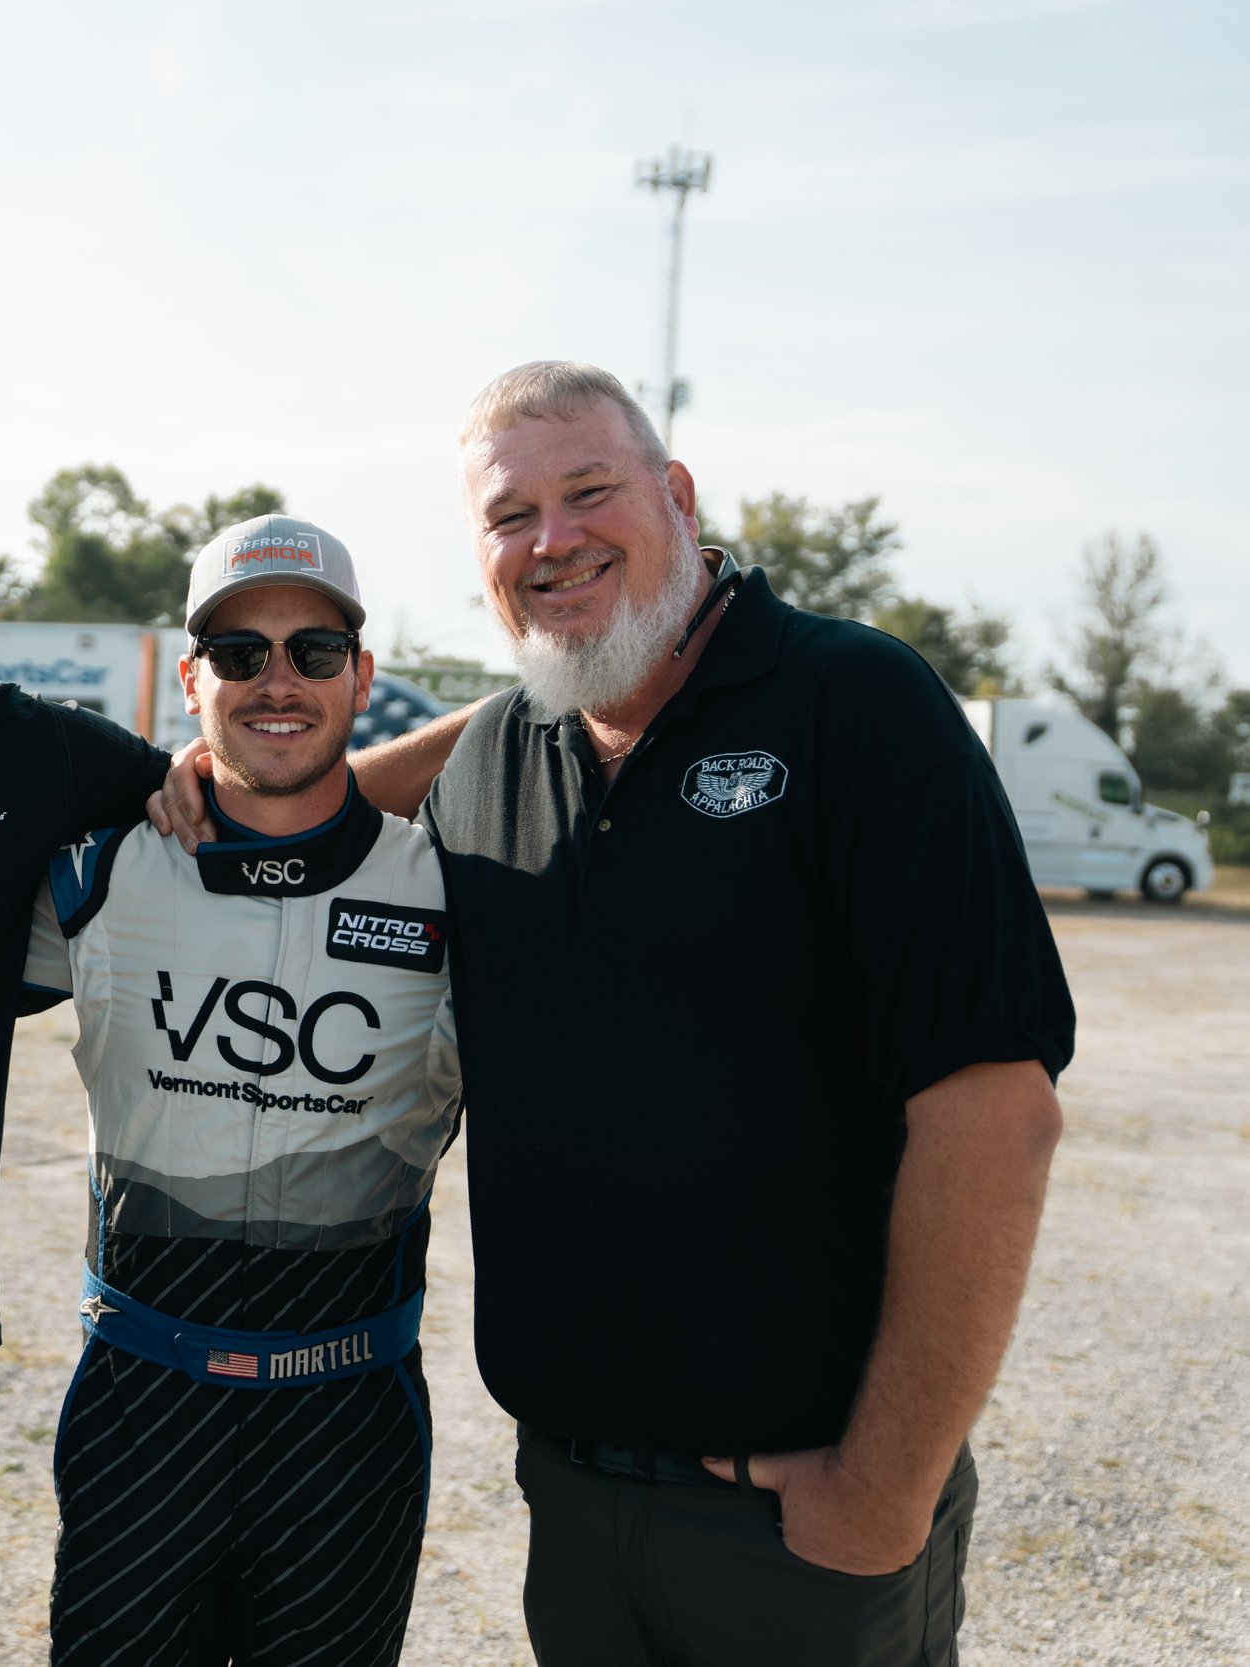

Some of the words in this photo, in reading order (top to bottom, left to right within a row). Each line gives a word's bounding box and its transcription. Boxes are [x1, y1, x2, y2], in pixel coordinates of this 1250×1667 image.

[230, 547, 317, 569] ARMOR
[232, 537, 309, 554] OFFROAD
[701, 759, 737, 773] BACK
[737, 757, 776, 771] ROADS
[690, 789, 770, 814] APPALACHIA
[241, 858, 306, 886] VSC
[337, 912, 426, 938] NITRO
[332, 929, 431, 956] CROSS
[150, 970, 382, 1086] VSC
[269, 1330, 373, 1380] MARTELL
